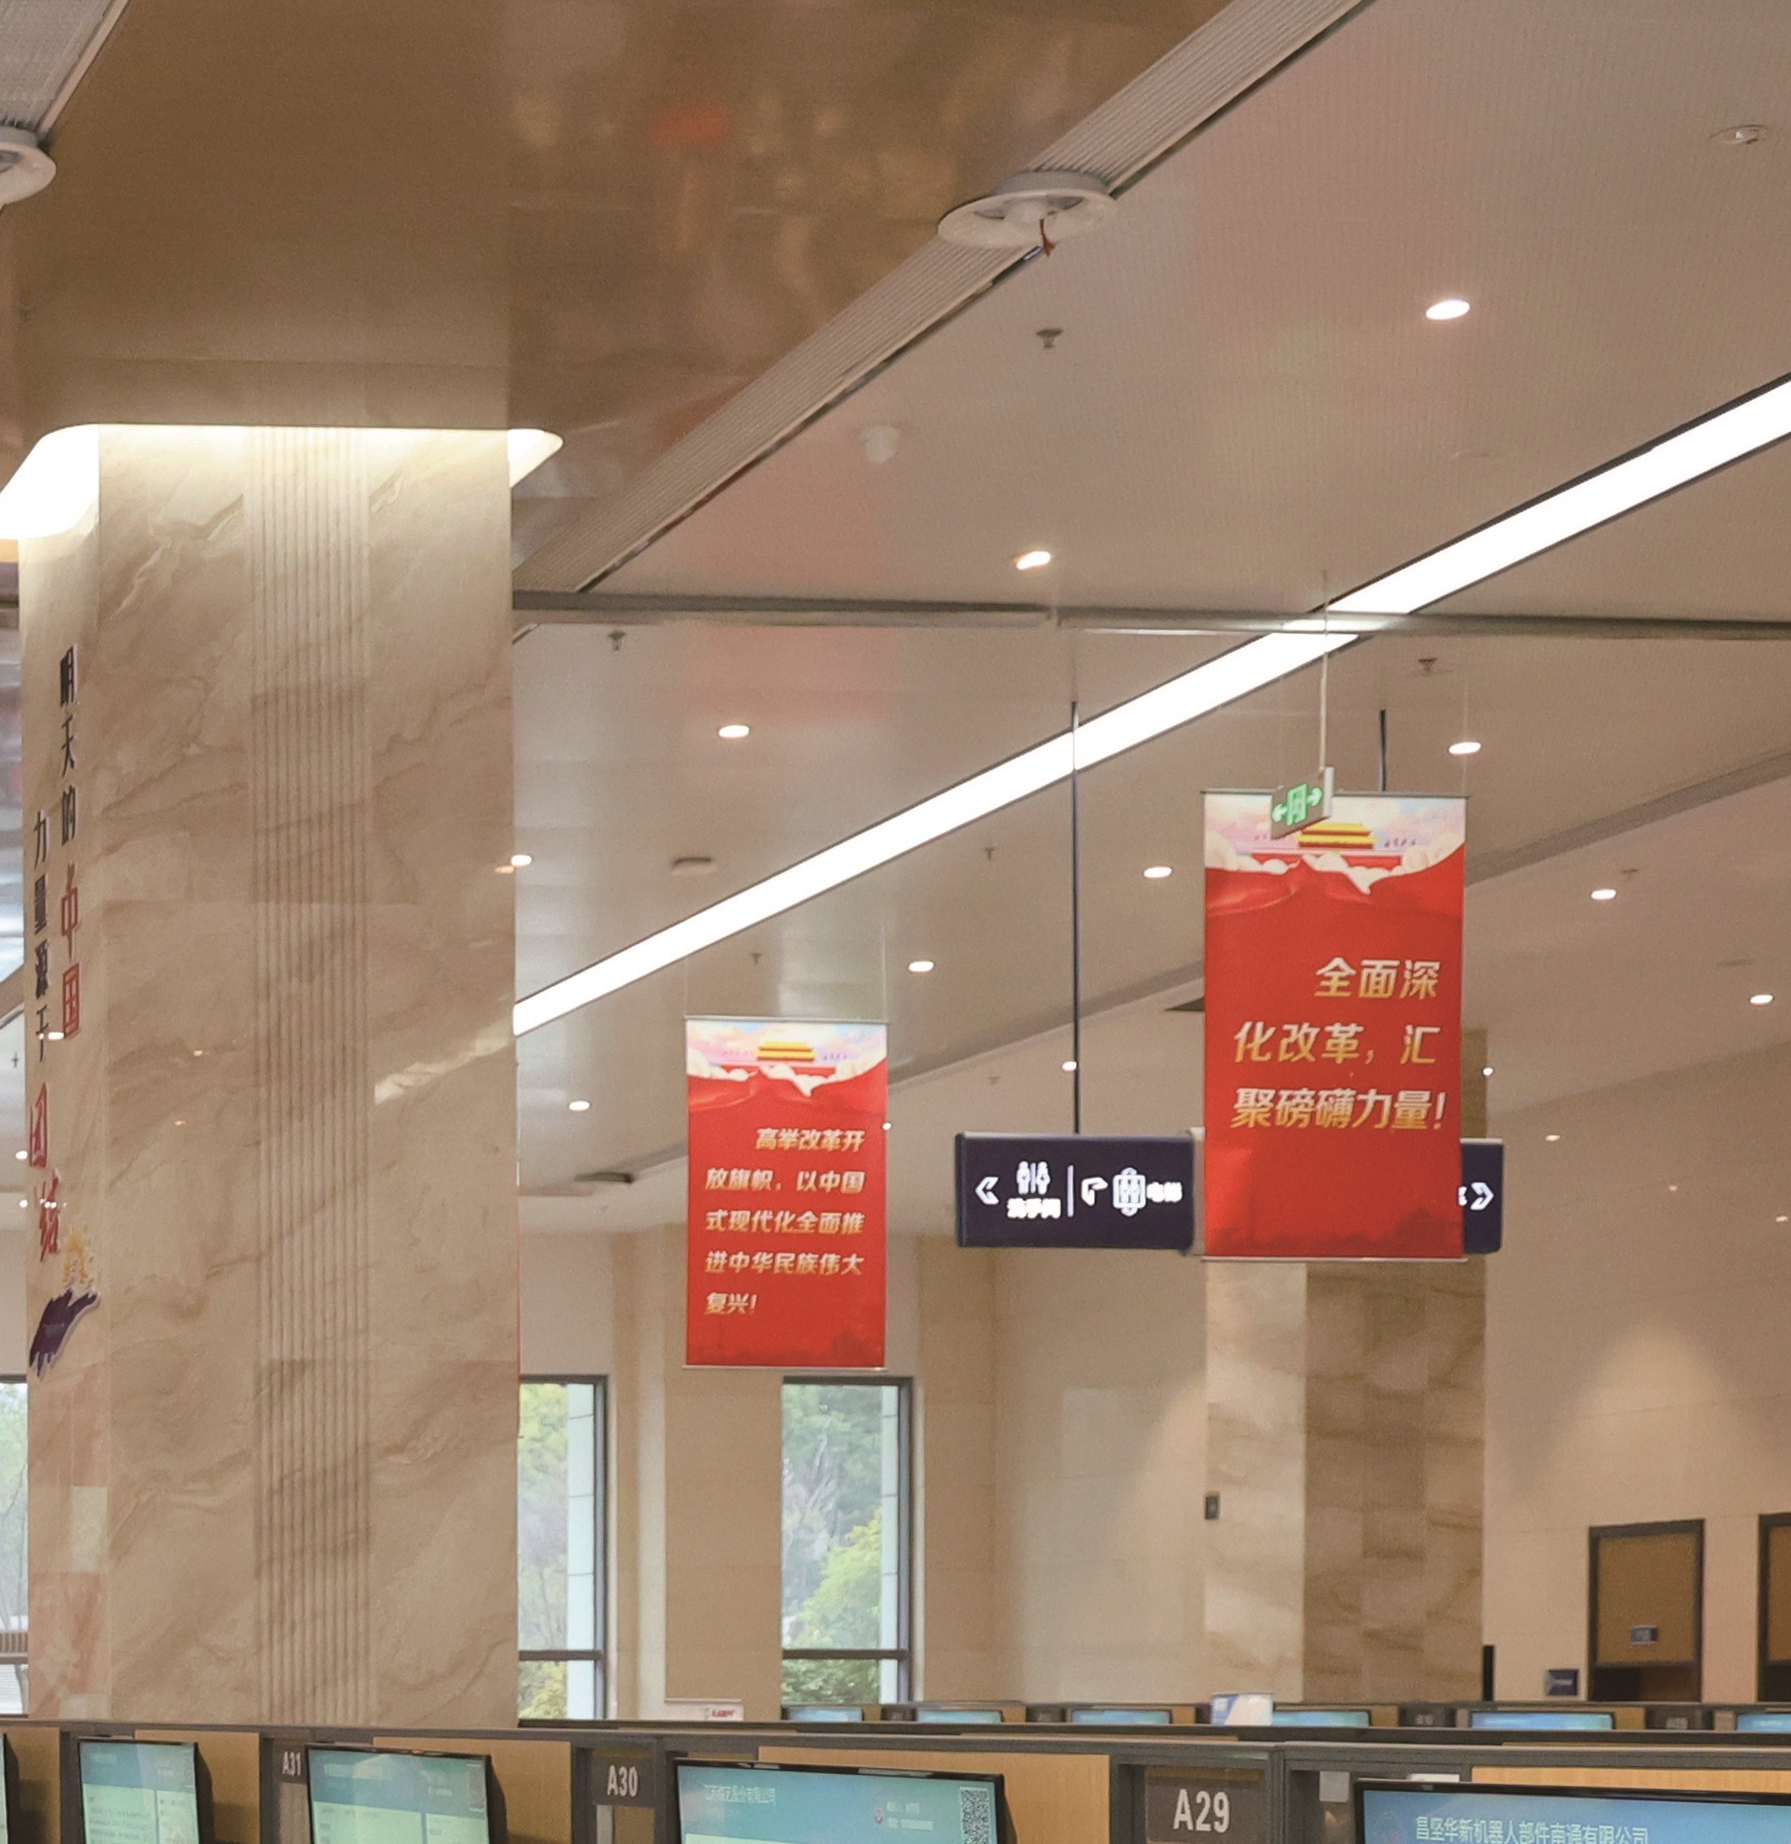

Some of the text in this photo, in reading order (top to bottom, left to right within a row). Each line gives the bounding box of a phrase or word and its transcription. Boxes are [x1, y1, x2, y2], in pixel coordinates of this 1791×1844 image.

[1314, 957, 1441, 999] 全面深
[1235, 1022, 1440, 1064] 化改革，汇
[755, 1128, 866, 1152] 高举改革开
[705, 1209, 866, 1235] 式现代化全面推
[704, 1251, 865, 1276] 进中华民族伟大
[607, 1766, 638, 1798] A30
[1173, 1791, 1230, 1832] A29
